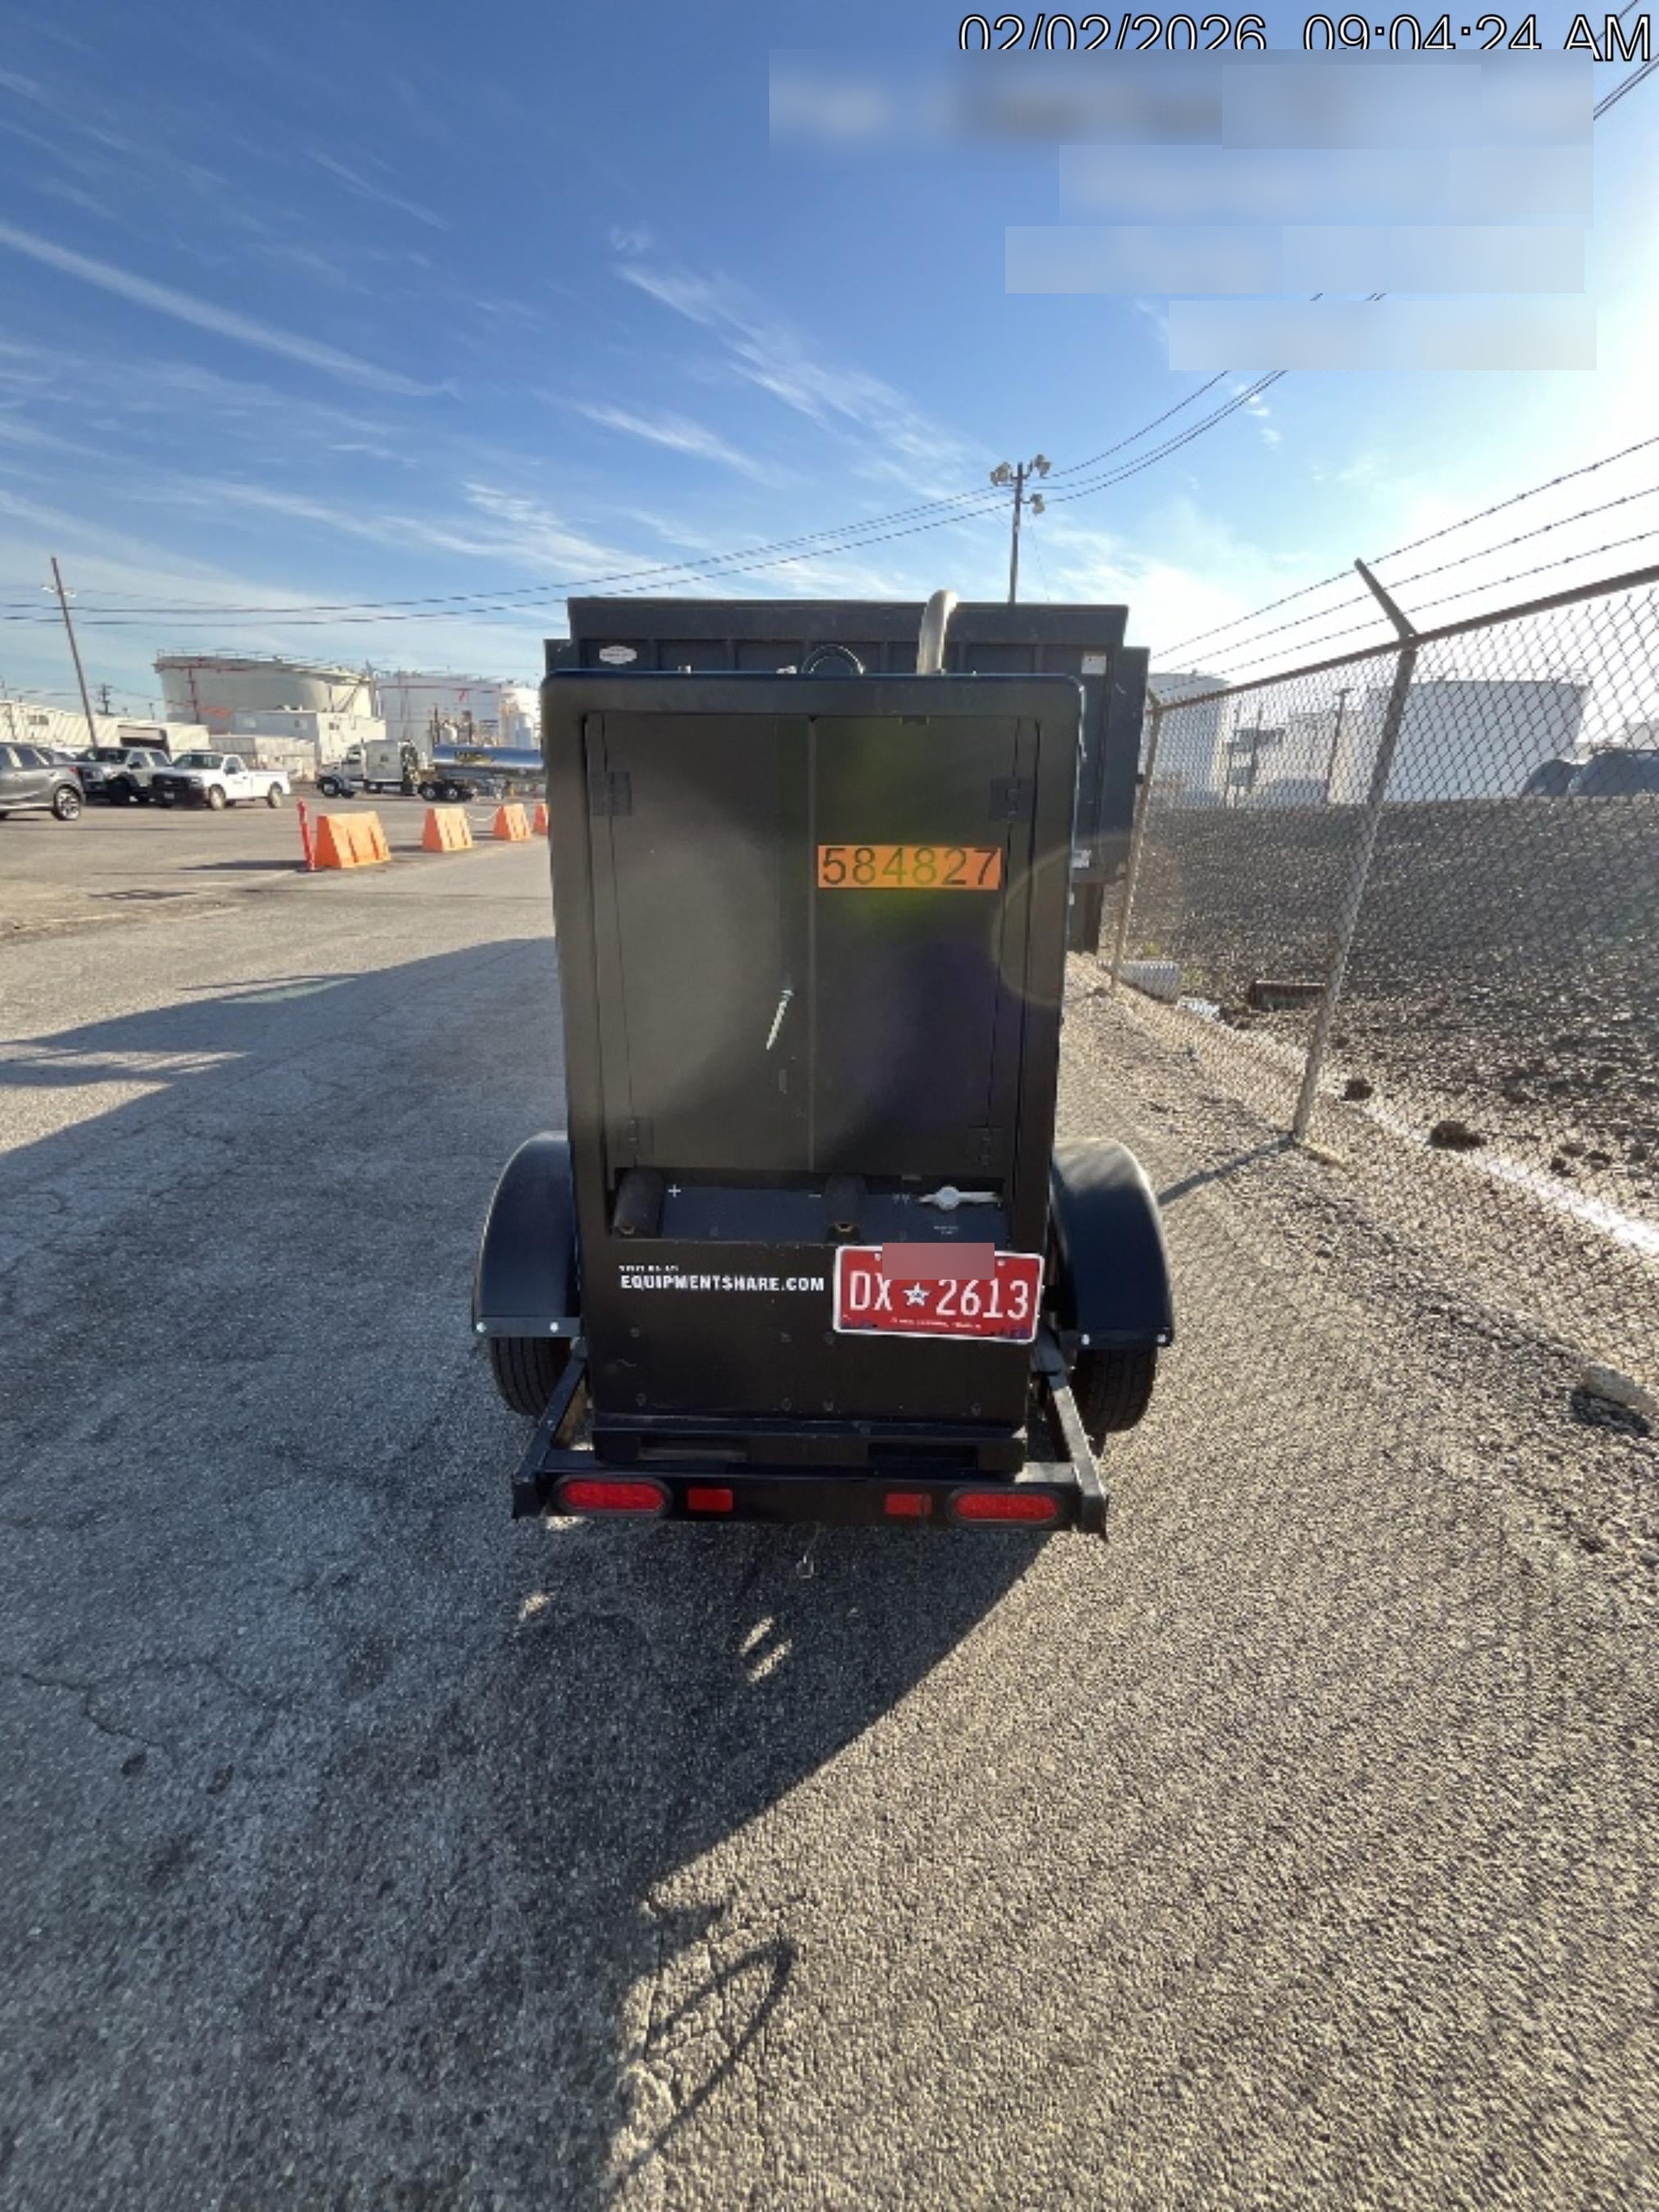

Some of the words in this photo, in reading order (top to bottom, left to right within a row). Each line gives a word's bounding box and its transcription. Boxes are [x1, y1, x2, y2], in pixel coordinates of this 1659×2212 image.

[822, 846, 999, 886] 584827
[621, 1274, 825, 1292] EQUIPMENTSHARE.COM
[849, 1270, 893, 1312] DX
[936, 1278, 1029, 1320] 2613
